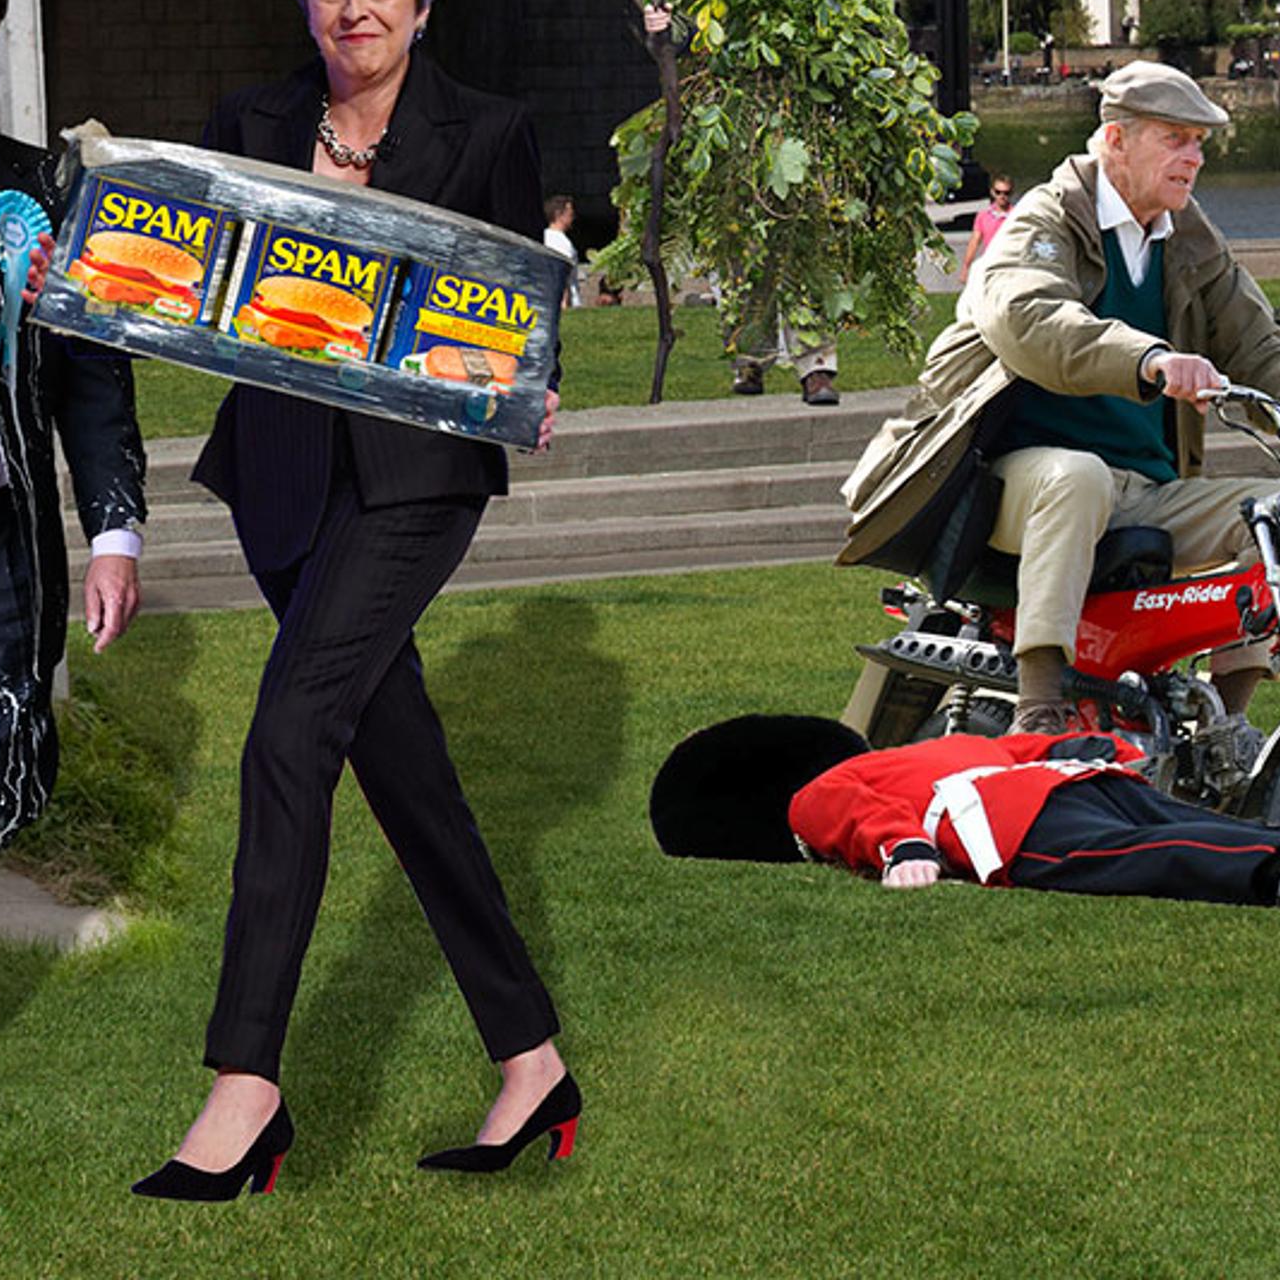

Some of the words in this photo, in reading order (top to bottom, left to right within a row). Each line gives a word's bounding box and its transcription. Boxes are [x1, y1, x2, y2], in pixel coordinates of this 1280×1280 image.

[98, 192, 213, 247] SPAM
[268, 237, 383, 293] SPAM
[431, 274, 539, 329] SPAM
[1132, 583, 1233, 611] Easy-Rider
